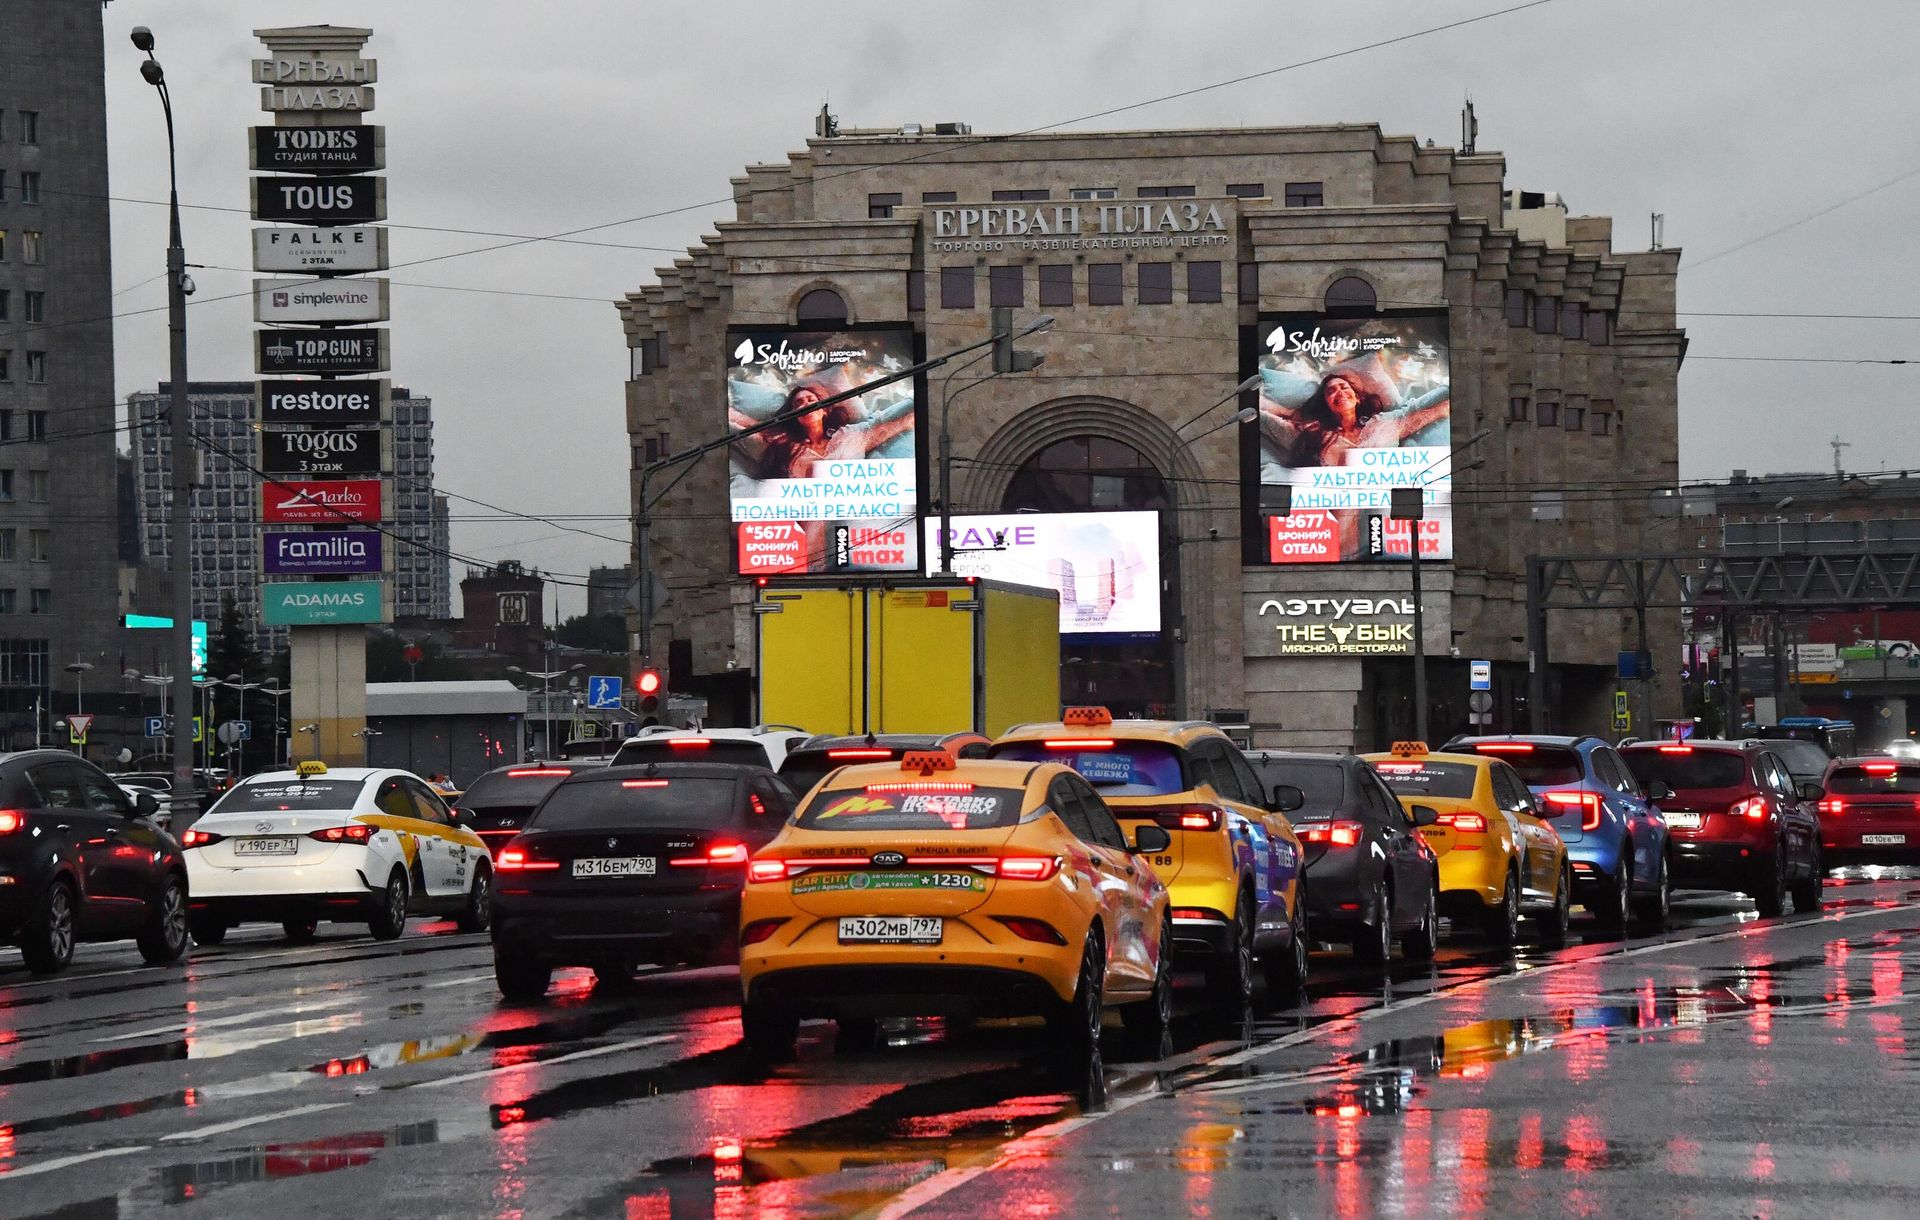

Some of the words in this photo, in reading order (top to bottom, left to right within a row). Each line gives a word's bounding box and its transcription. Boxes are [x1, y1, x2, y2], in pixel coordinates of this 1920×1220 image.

[260, 60, 368, 82] ЕРЕВАН
[270, 88, 361, 109] ПЛАЗА
[274, 130, 358, 149] TODES
[274, 152, 317, 162] СТУДИЯ
[321, 152, 358, 162] ТАНЦА
[280, 186, 353, 210] TOUS
[933, 206, 1081, 237] ЕРЕВАН
[1098, 202, 1227, 233] ПЛАЗА
[271, 232, 363, 244] FALKE
[934, 241, 1004, 252] ТОРГОВО
[1180, 236, 1230, 248] ЦЕНТР
[309, 257, 335, 265] ЭТАЖ
[293, 291, 369, 308] simplewine
[296, 340, 361, 357] TOPGUN
[1287, 327, 1358, 357] Sofrino
[366, 347, 373, 358] 3
[754, 339, 826, 370] Sofrino
[271, 392, 370, 410] restore:
[300, 460, 307, 472] 3
[311, 462, 343, 471] этаж
[1362, 451, 1430, 468] ОТДЫХ
[829, 462, 895, 479] ОТДЫХ
[1313, 471, 1434, 487] УЛЬТРАМАКС
[780, 482, 899, 498] УЛЬТРАМАКС
[1290, 490, 1350, 508] ЛНЫЙ
[1357, 491, 1436, 507] РЕЛС!
[735, 501, 819, 519] ПОЛНЫЙ
[824, 502, 901, 518] РЕЛАКС!
[1384, 517, 1440, 535] Ulra
[851, 527, 905, 546] Ultra
[1277, 530, 1331, 541] БРОНИРУЙ
[1370, 517, 1382, 554] ТАРИФ
[278, 537, 366, 557] Familia
[746, 540, 799, 552] БРОНИРУЙ
[837, 528, 848, 565] ТАРИФ
[1282, 543, 1327, 555] ОТЕЛЬ
[750, 554, 795, 566] ОТЕЛЬ
[851, 549, 905, 565] max
[282, 593, 365, 606] ADAMAS
[1276, 625, 1326, 641] THE
[1357, 624, 1414, 641] БЫК
[1282, 643, 1337, 653] МЯСНОЙ
[1340, 644, 1406, 653] РЕСТОРАН
[1082, 769, 1129, 779] КЕШБЭКА
[1095, 761, 1130, 770] МНОГО
[283, 840, 294, 848] 71
[575, 860, 629, 874] М316ЕМ
[631, 858, 652, 868] 790
[1155, 856, 1172, 865] 88
[845, 920, 908, 936] Н302МВ
[913, 919, 937, 931] 797
